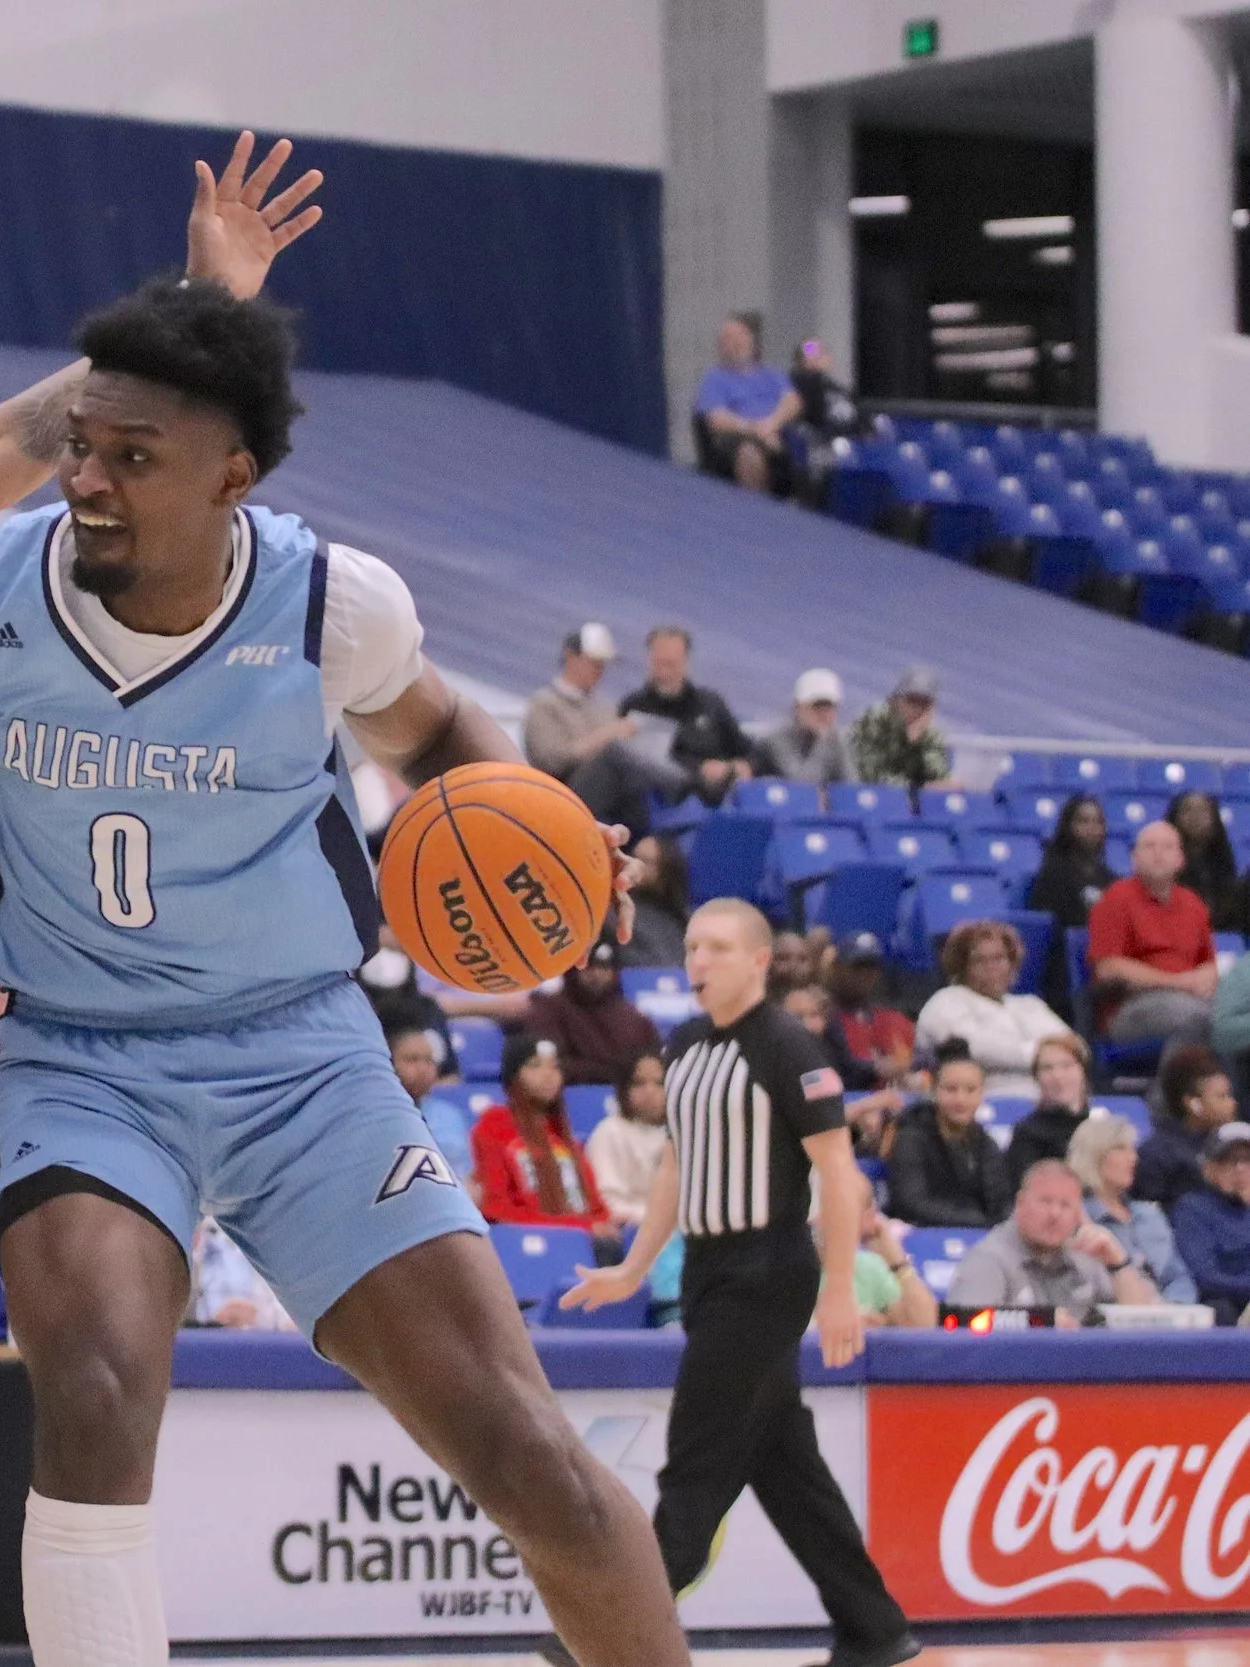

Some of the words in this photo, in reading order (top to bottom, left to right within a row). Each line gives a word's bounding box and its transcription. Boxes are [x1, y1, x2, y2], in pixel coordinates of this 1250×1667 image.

[3, 717, 238, 794] AUGUSTA
[88, 811, 157, 930] 0
[503, 861, 575, 956] NCAA
[338, 1463, 479, 1524] New
[938, 1395, 1250, 1607] Coca-C
[271, 1519, 530, 1585] Channe
[420, 1589, 534, 1618] WJBF-TV
